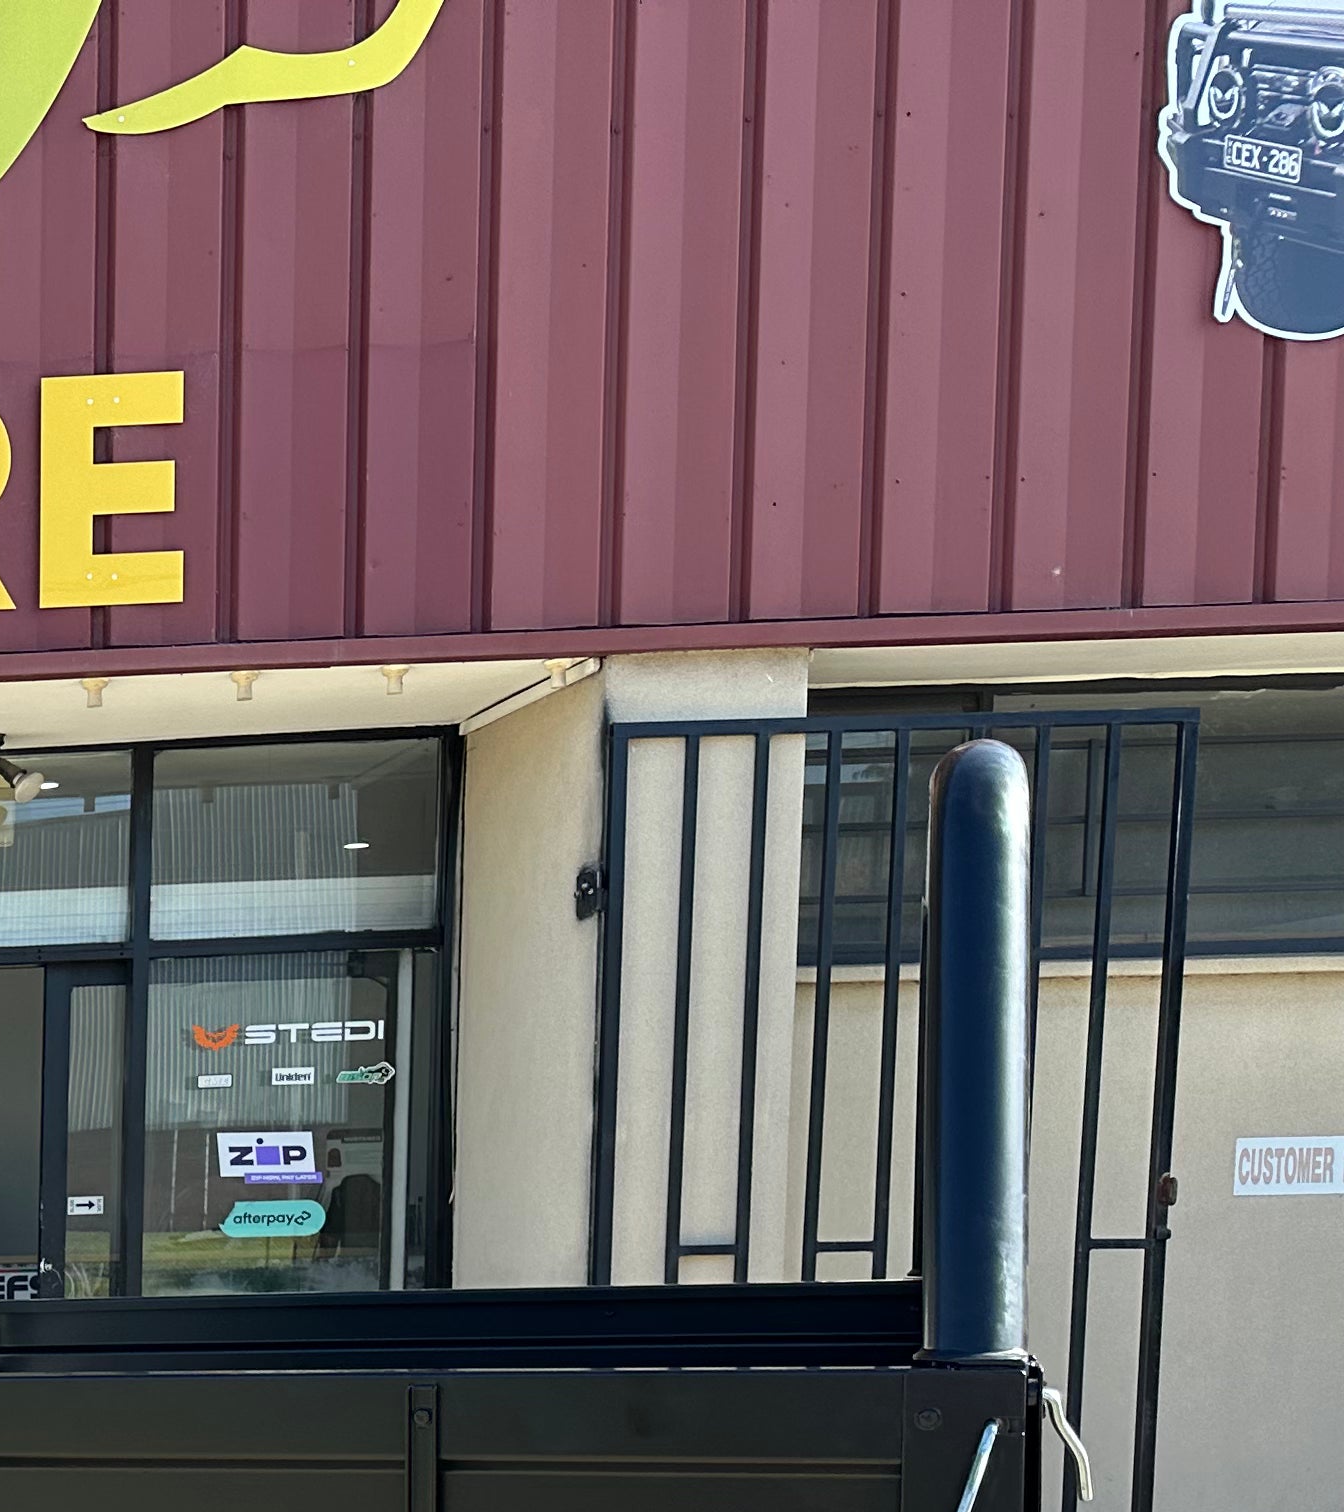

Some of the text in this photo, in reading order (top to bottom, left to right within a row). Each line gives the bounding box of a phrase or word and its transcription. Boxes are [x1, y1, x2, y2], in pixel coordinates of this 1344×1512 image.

[244, 1019, 385, 1045] STEDI
[1238, 1146, 1335, 1186] CUSTOMER
[233, 1211, 295, 1226] afterpay
